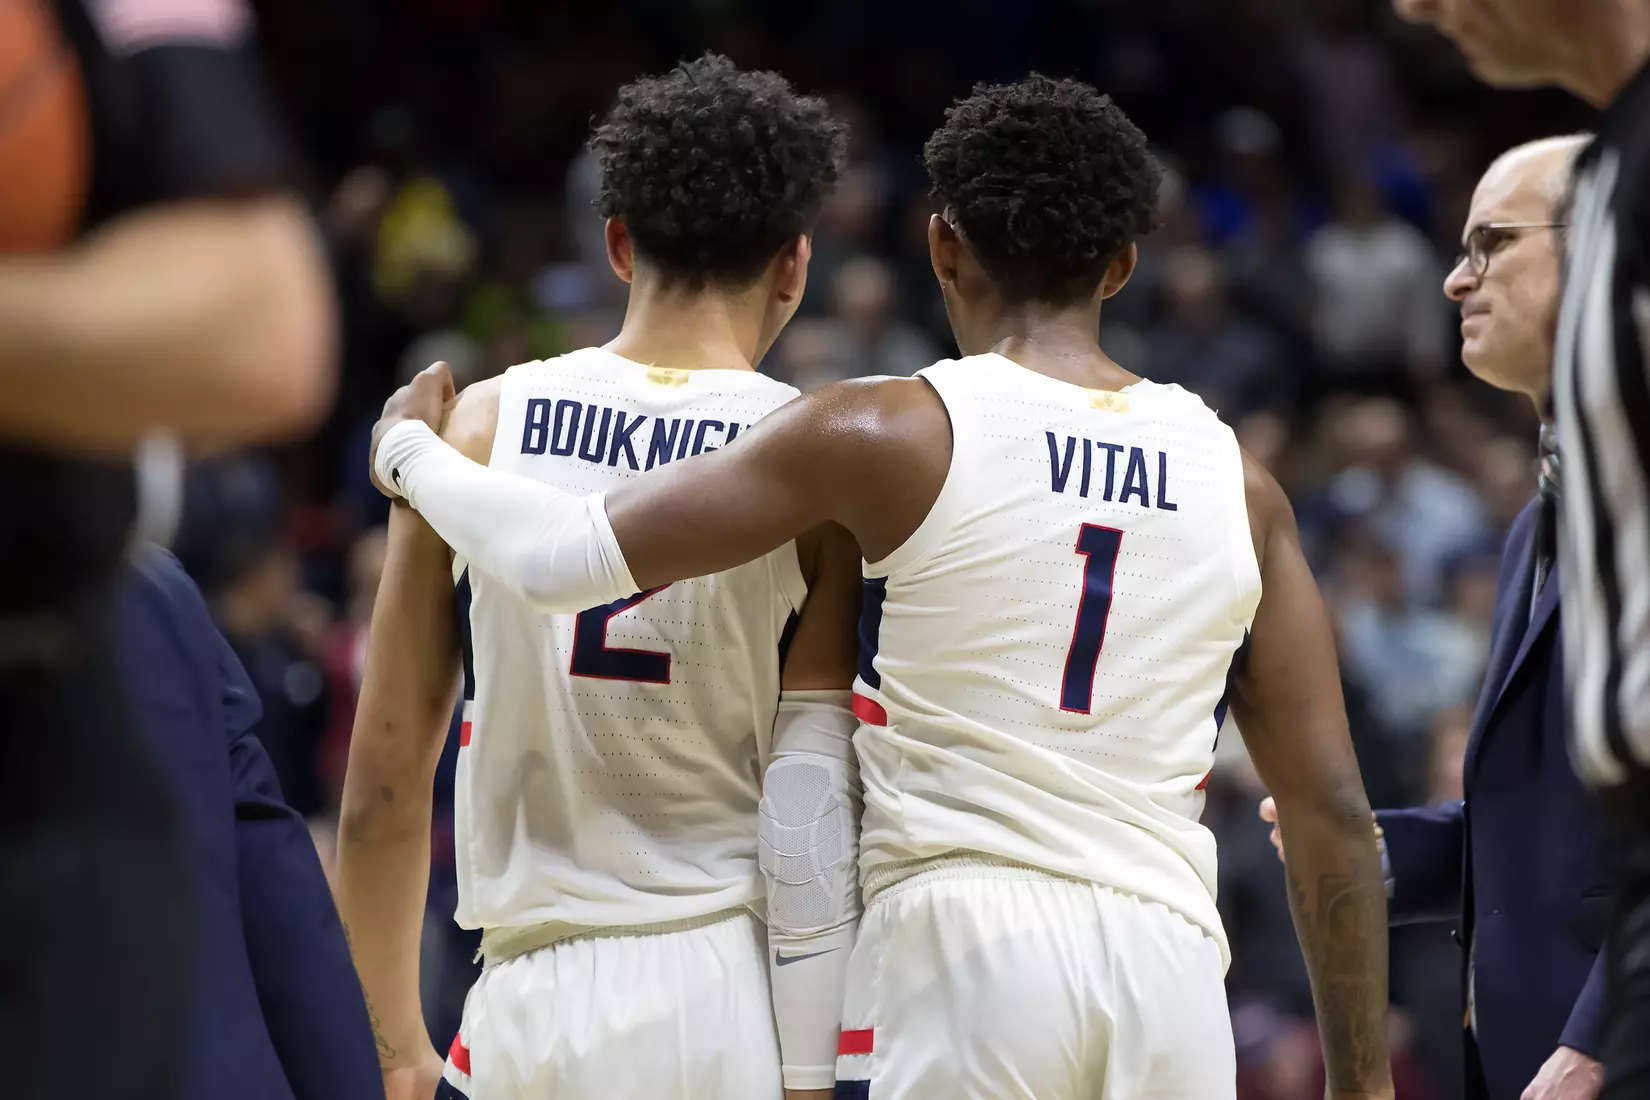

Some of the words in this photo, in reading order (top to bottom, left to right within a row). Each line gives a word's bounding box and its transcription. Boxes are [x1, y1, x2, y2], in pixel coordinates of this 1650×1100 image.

[520, 398, 752, 472] BOUKNIG
[1045, 431, 1178, 511] VITAL
[569, 582, 672, 685] 2
[1059, 522, 1124, 714] 1
